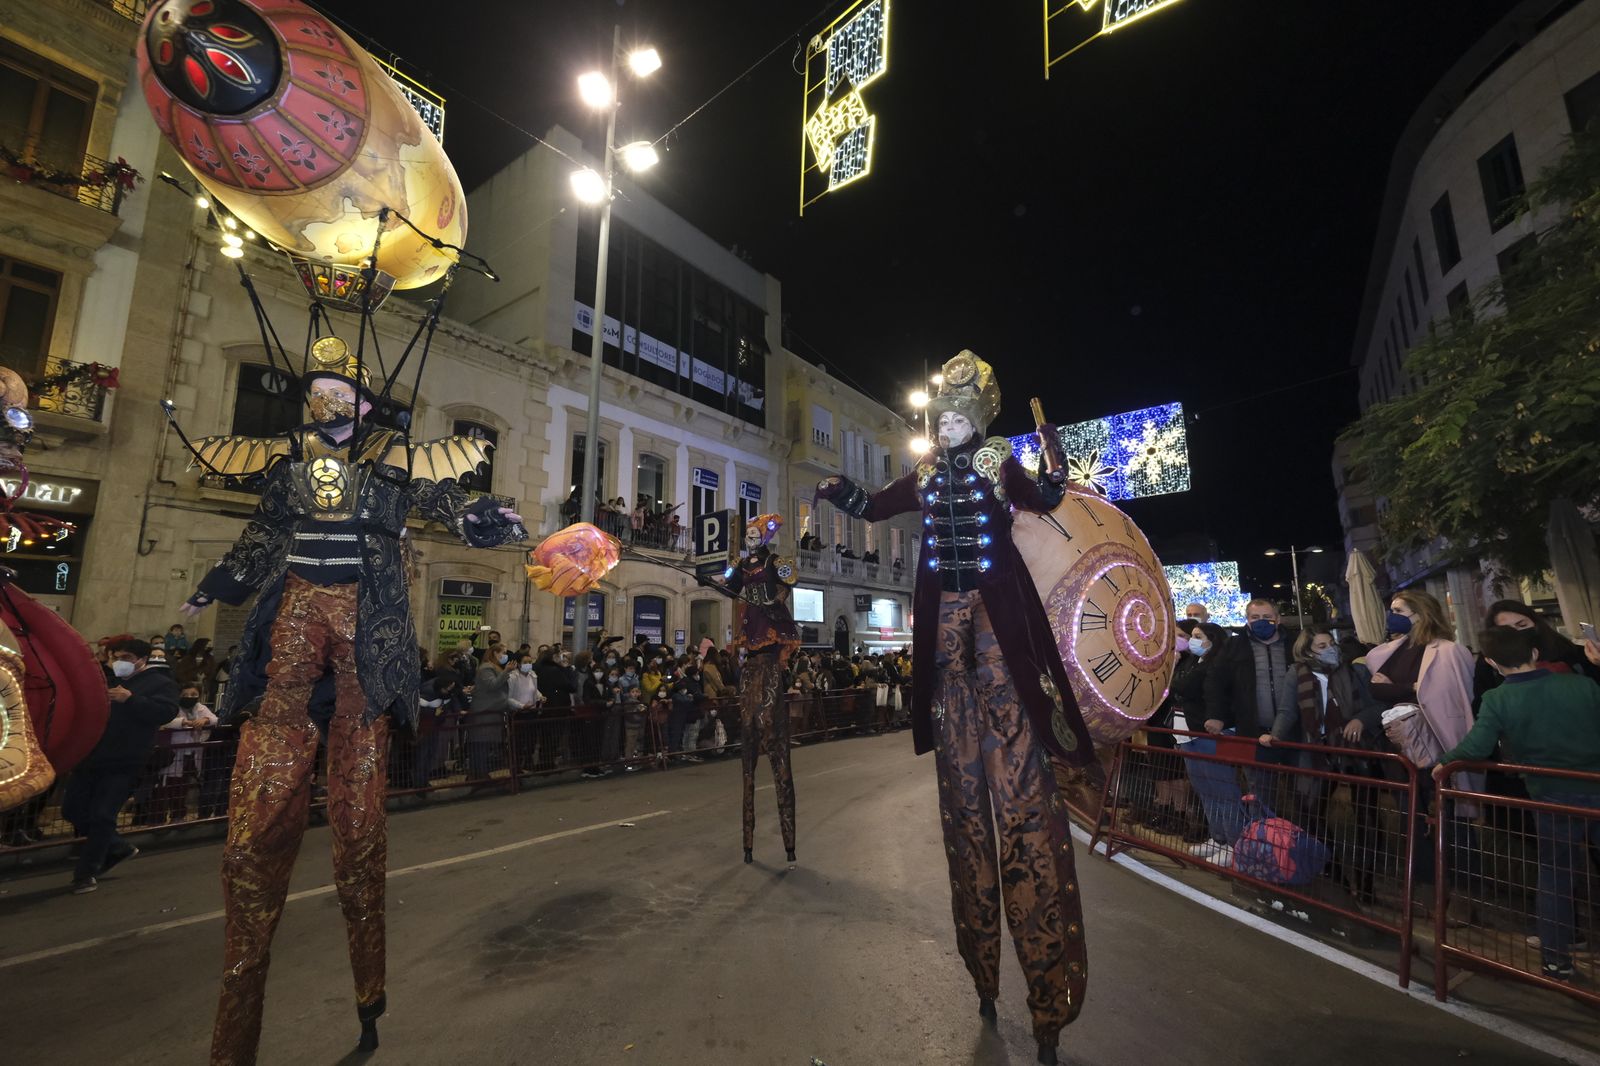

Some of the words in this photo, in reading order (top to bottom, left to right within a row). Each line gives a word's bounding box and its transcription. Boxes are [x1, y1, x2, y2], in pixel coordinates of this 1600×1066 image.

[703, 517, 720, 553] P
[440, 604, 452, 615] SE
[454, 604, 482, 616] VENDE
[440, 619, 445, 630] O
